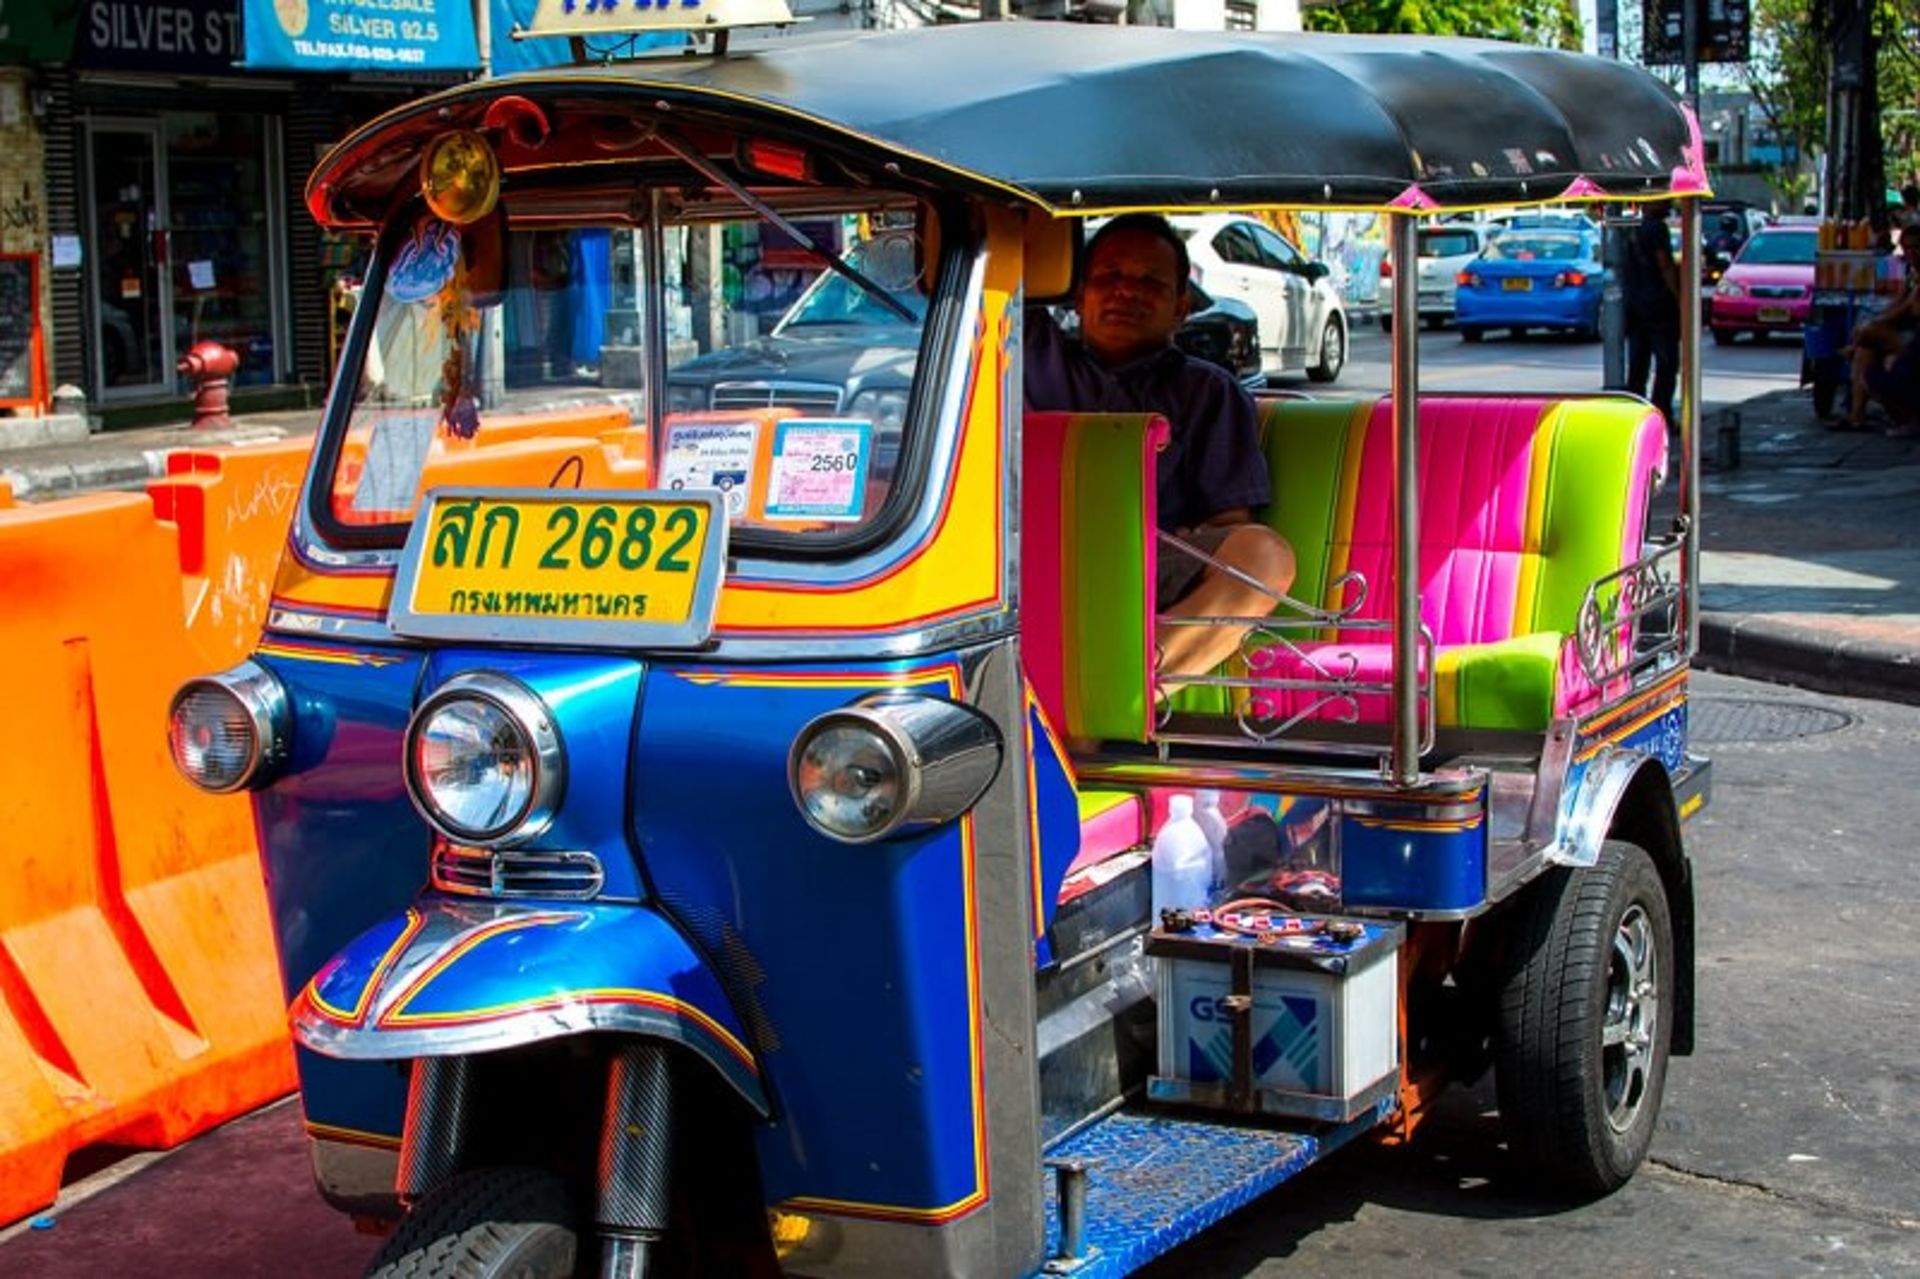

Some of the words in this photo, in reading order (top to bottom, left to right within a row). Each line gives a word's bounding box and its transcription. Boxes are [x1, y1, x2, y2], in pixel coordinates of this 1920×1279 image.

[90, 2, 196, 54] SILVER
[204, 10, 241, 55] ST
[329, 13, 397, 39] SILVER
[401, 20, 440, 42] 92.5
[811, 453, 858, 472] 2560
[432, 498, 521, 569] สก
[538, 504, 699, 573] 2682
[449, 589, 648, 616] กรงเทพมหานคร
